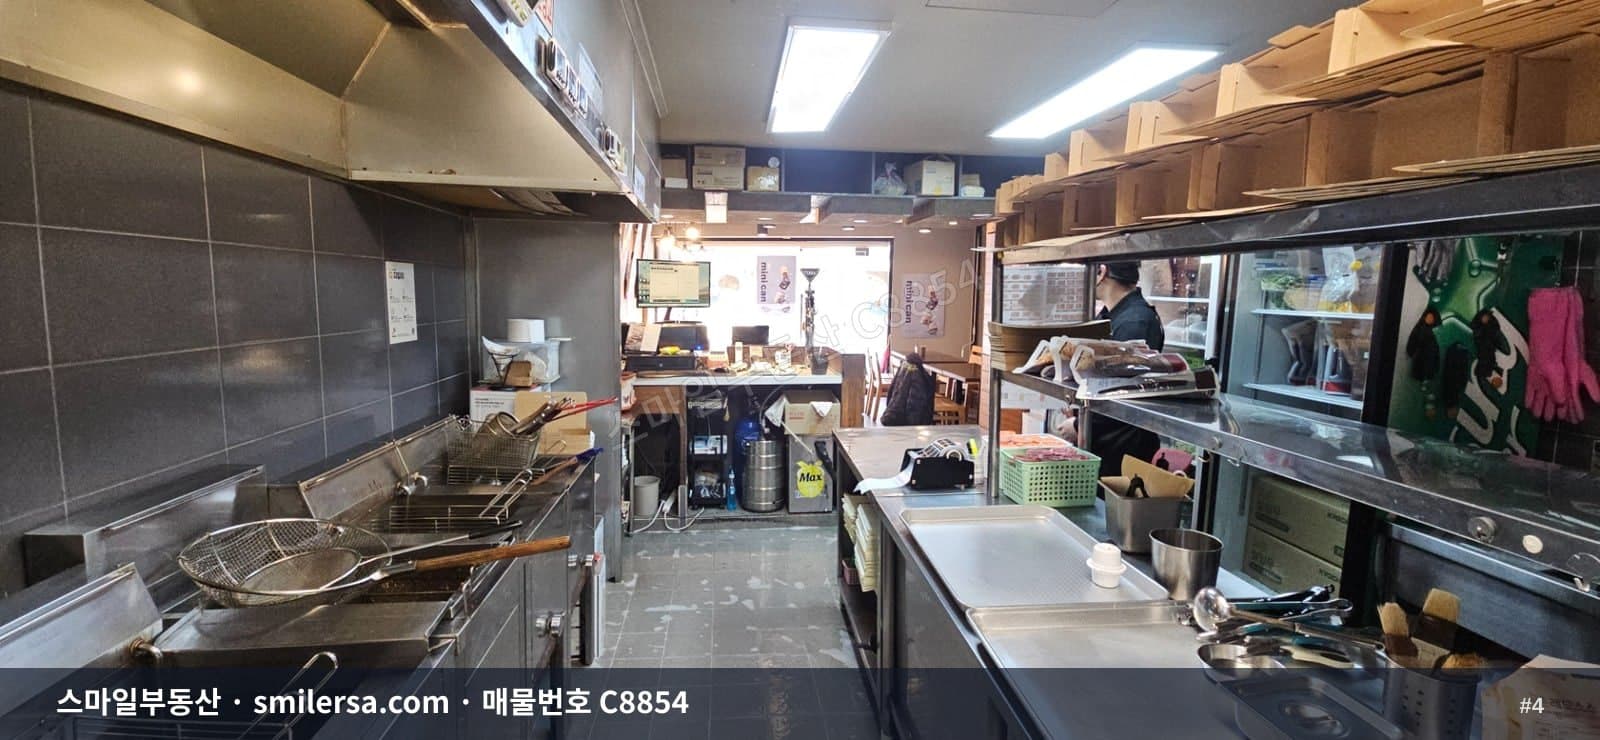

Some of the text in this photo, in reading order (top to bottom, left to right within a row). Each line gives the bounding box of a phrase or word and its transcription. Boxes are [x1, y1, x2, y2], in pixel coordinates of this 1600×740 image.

[760, 262, 769, 283] mini
[905, 280, 914, 303] mini
[799, 472, 822, 482] Max
